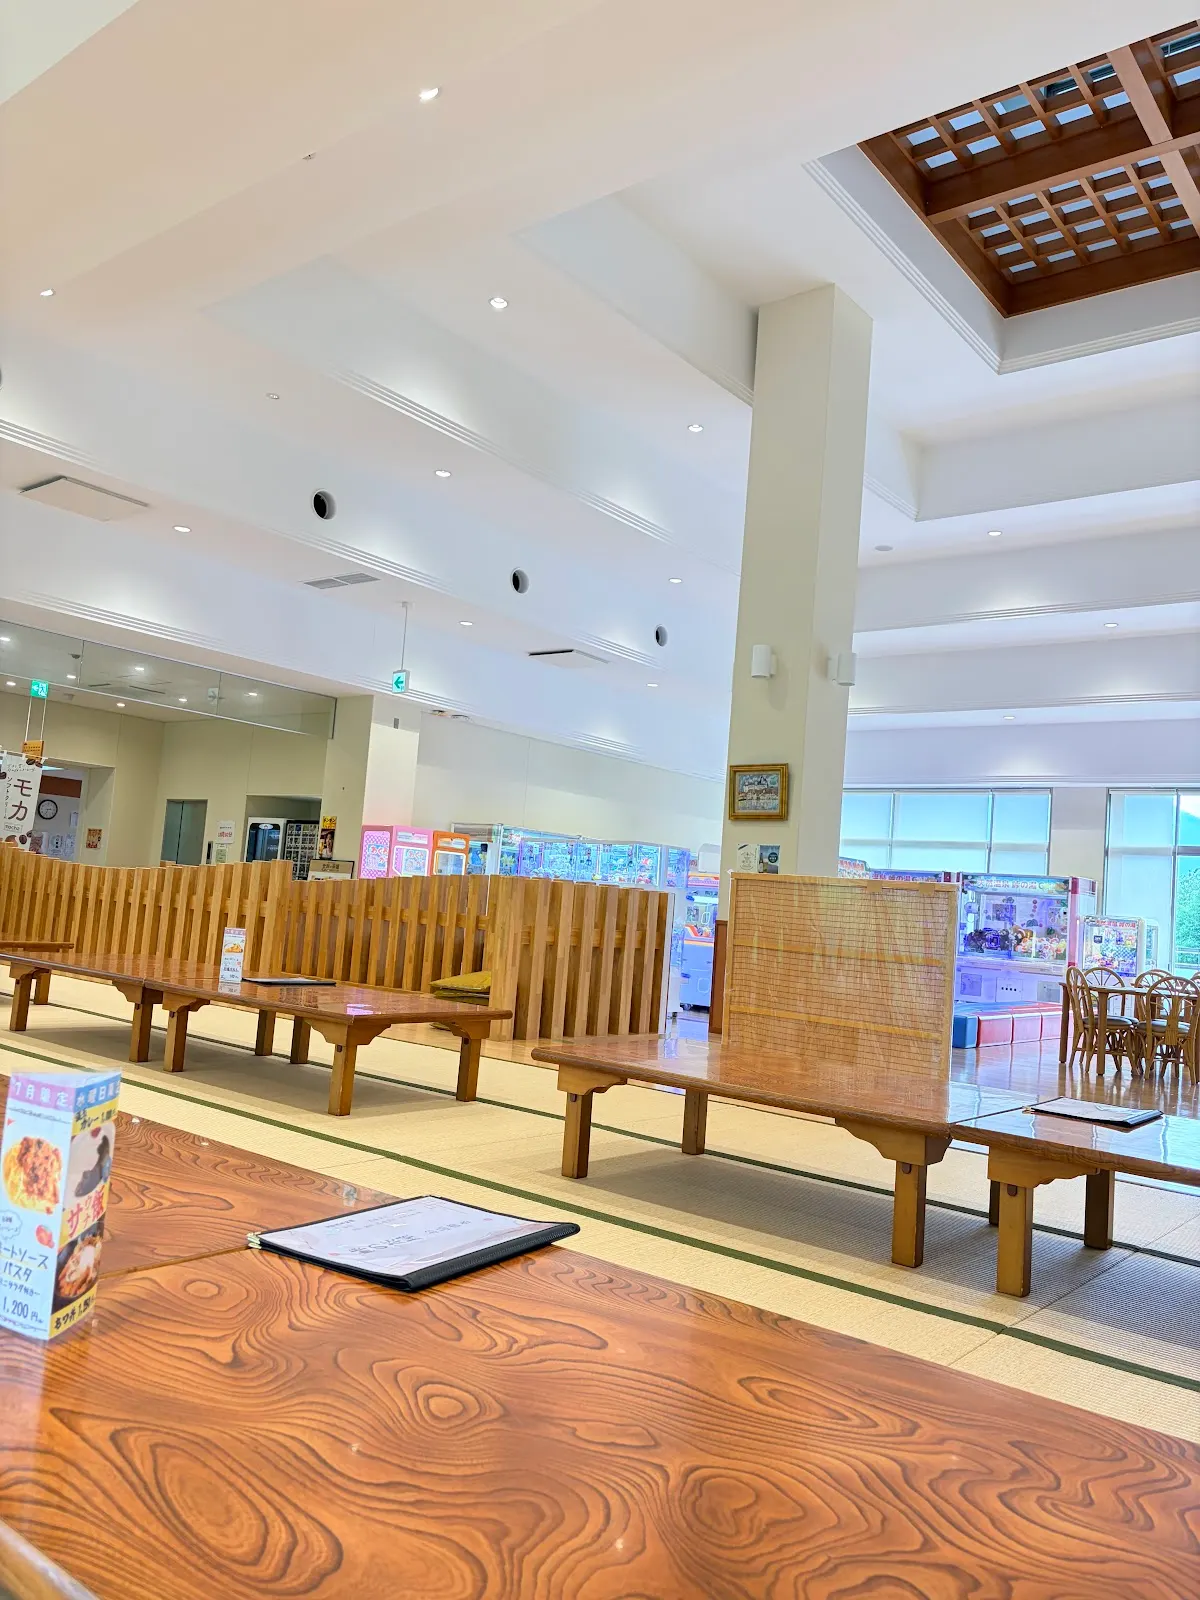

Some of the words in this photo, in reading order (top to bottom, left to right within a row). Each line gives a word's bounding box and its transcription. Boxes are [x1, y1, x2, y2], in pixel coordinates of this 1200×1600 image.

[8, 778, 33, 822] モカ
[0, 1243, 48, 1269] ートソース
[4, 1260, 32, 1282] パスタ
